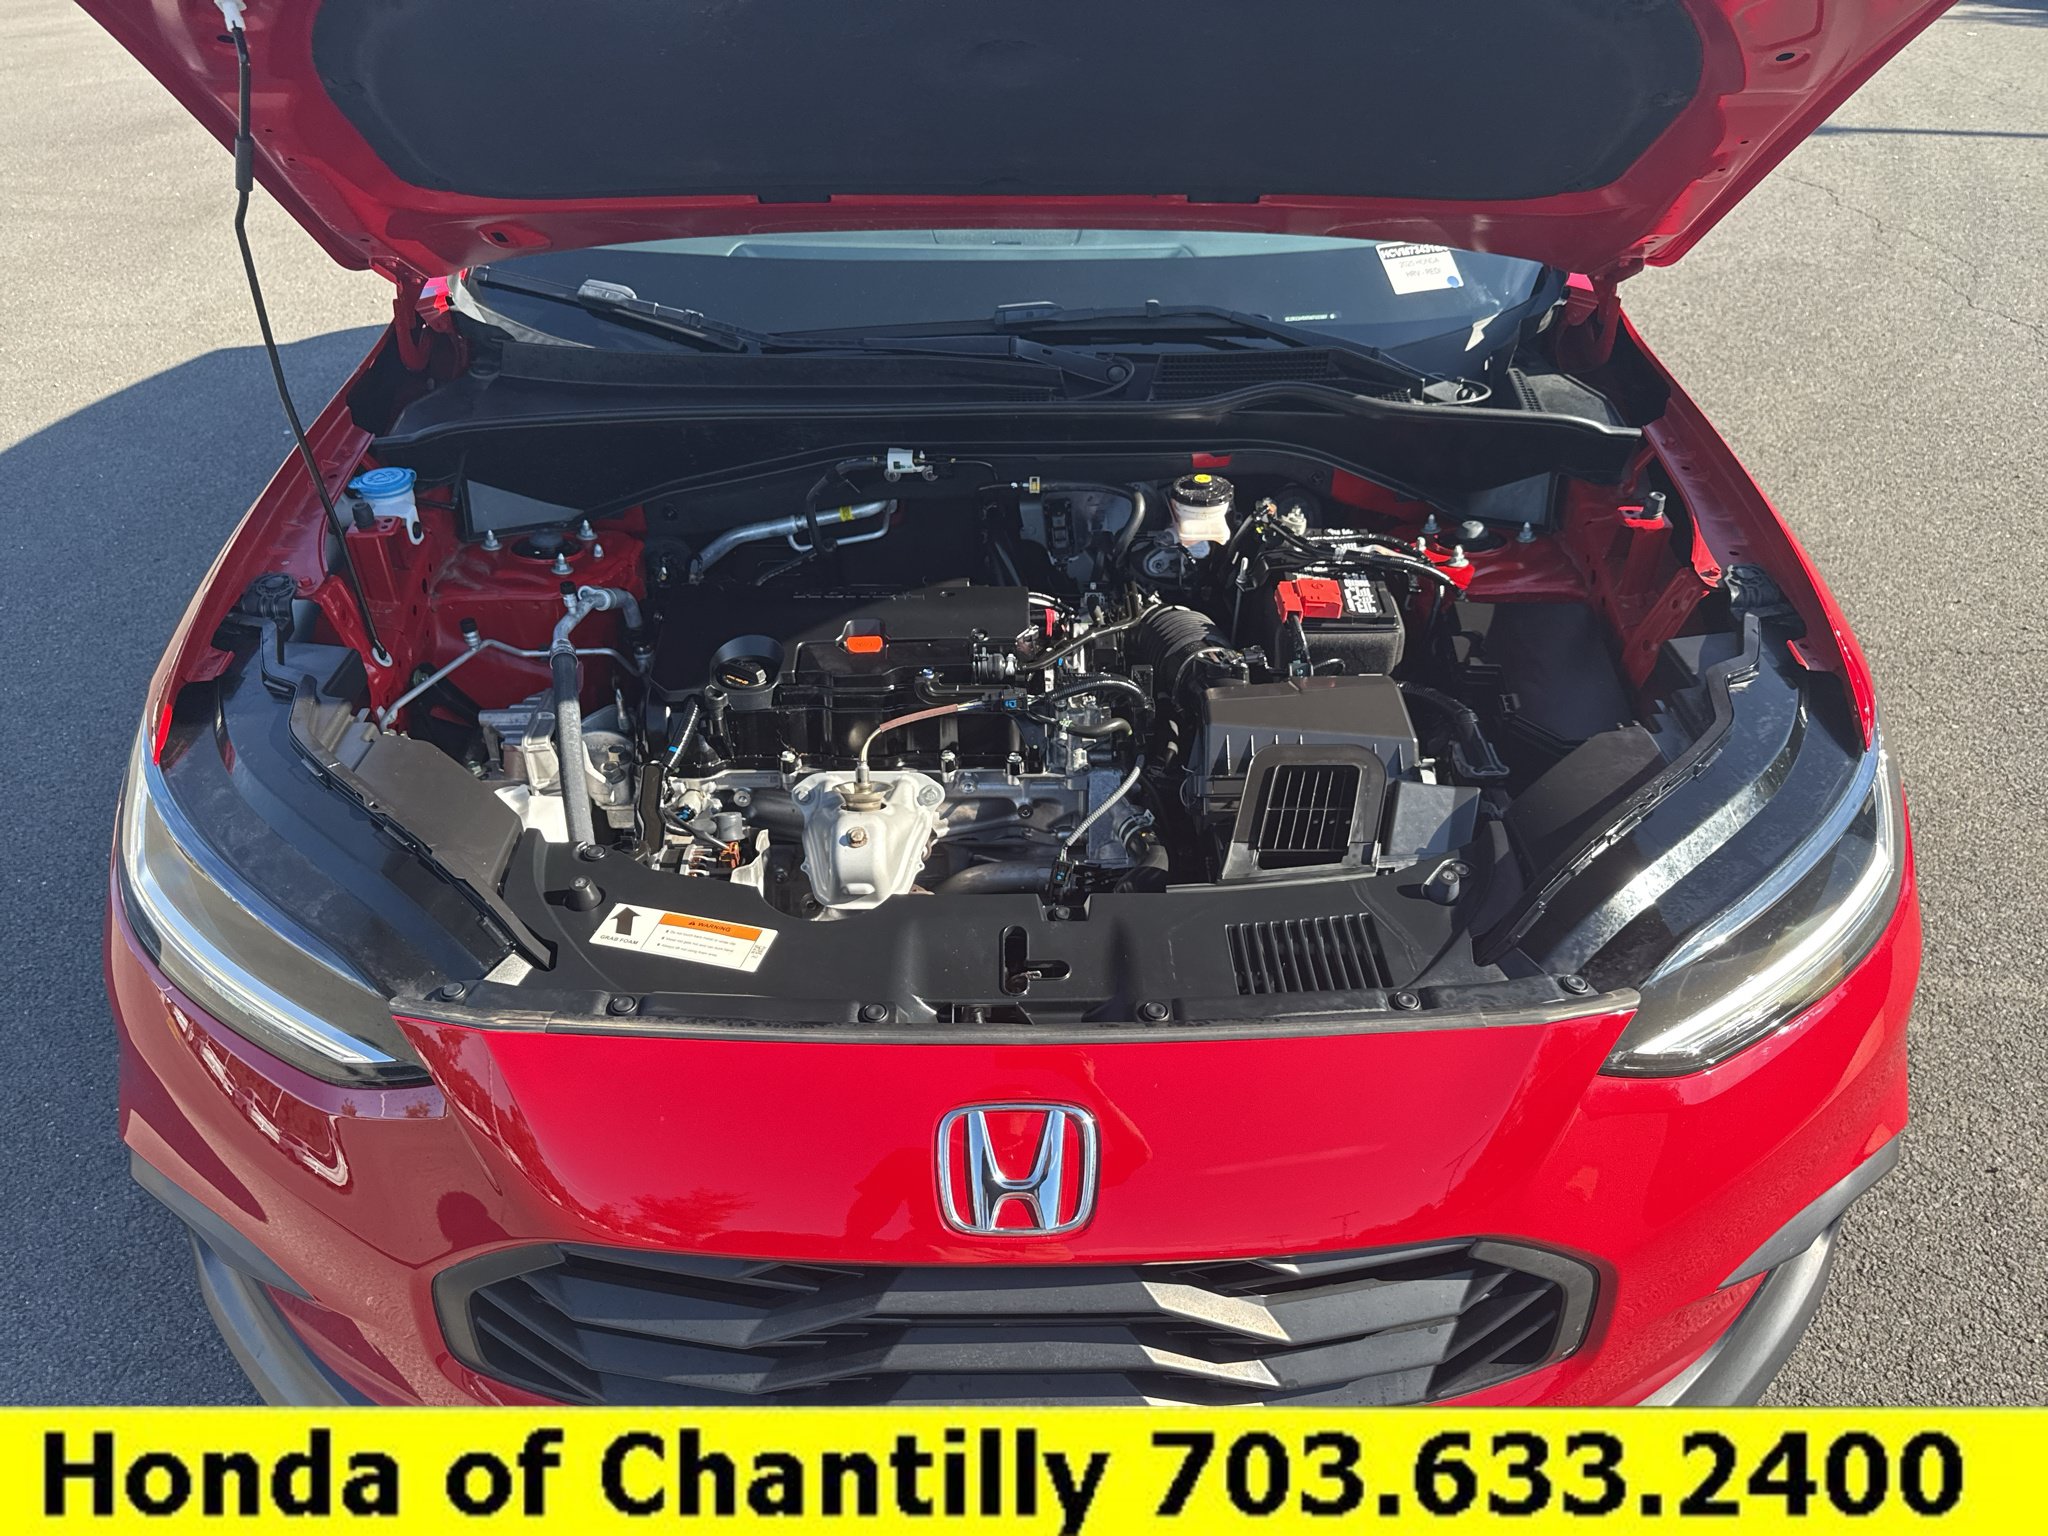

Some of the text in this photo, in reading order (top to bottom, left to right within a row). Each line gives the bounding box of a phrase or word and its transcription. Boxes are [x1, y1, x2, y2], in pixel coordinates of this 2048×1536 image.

[698, 921, 731, 932] WARNING
[600, 934, 639, 946] GRAB FOAM
